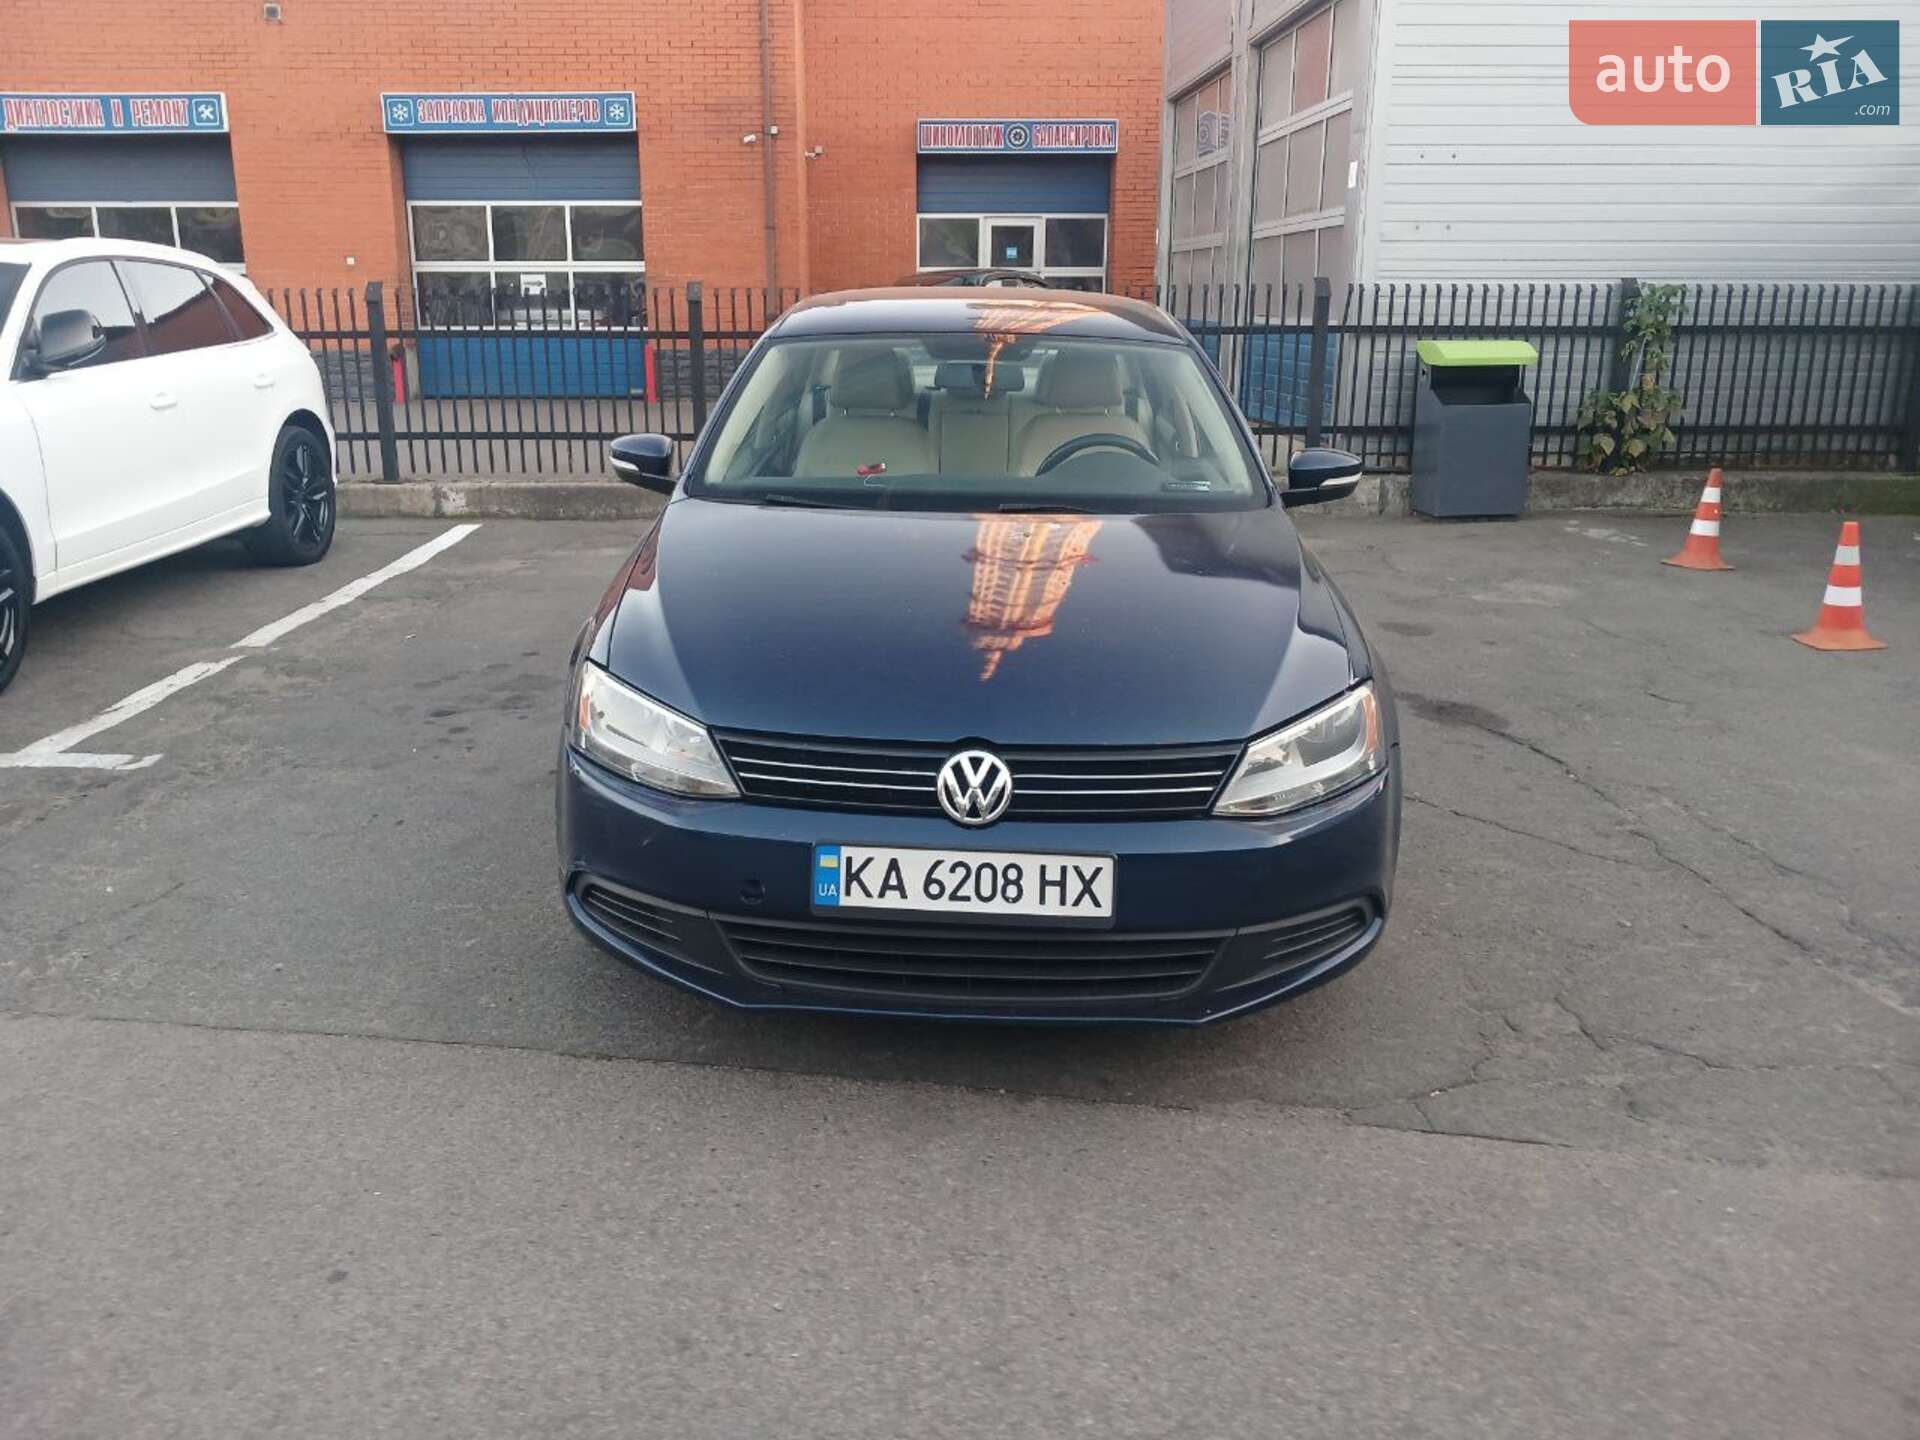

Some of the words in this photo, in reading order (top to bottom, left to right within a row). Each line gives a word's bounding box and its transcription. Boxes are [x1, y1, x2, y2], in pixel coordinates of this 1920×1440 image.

[4, 98, 105, 132] ДИАГНОСТИКА
[110, 98, 124, 127] И
[129, 98, 189, 127] РЕМОНТ
[416, 98, 487, 124] ЗАПРАВКА
[492, 98, 600, 126] КОНДИЦИОНЕРОВ
[921, 124, 1004, 148] ШИНОМОНТАЖ
[819, 884, 839, 897] UA
[844, 856, 908, 900] KA
[923, 859, 1024, 904] 6208
[1038, 864, 1104, 908] HX
